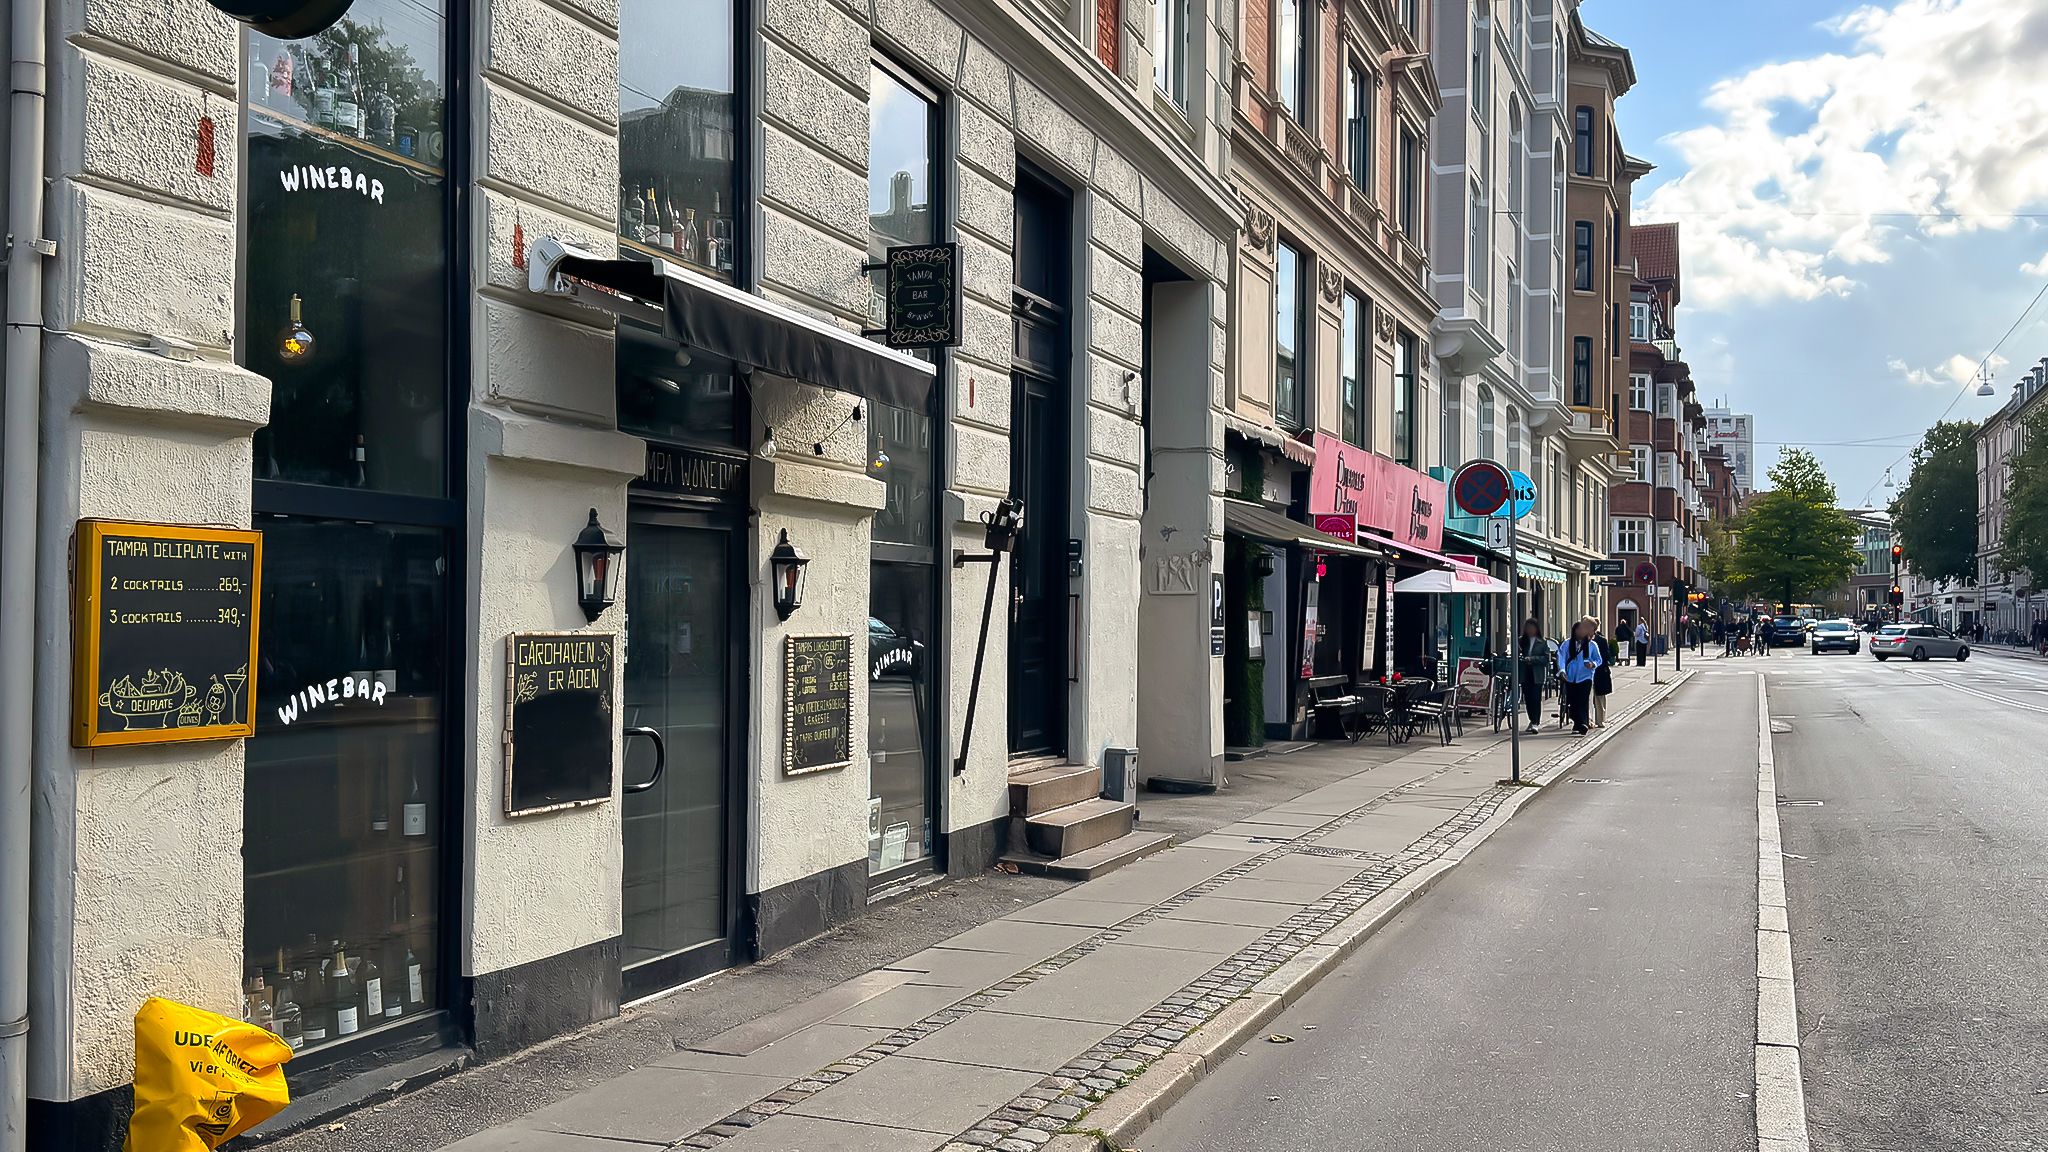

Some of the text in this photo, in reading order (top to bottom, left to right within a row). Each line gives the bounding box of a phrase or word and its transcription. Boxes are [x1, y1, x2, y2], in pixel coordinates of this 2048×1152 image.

[280, 164, 384, 205] WINEBAR
[907, 271, 933, 281] TAMPA
[912, 291, 928, 299] BAR
[643, 450, 674, 485] MPA
[107, 541, 247, 561] TAMPA DELIPLATE WITH
[110, 576, 118, 590] 2
[123, 580, 183, 591] COCKTAILS
[109, 609, 118, 624] 3
[121, 612, 182, 624] COCKTAILS
[518, 640, 595, 666] GÅRDHAVEN
[872, 648, 912, 680] WINEBAR
[548, 670, 564, 690] ER
[130, 698, 174, 712] DELIPLATE
[278, 676, 386, 725] WINEBAR
[189, 1060, 219, 1075] Vi er
